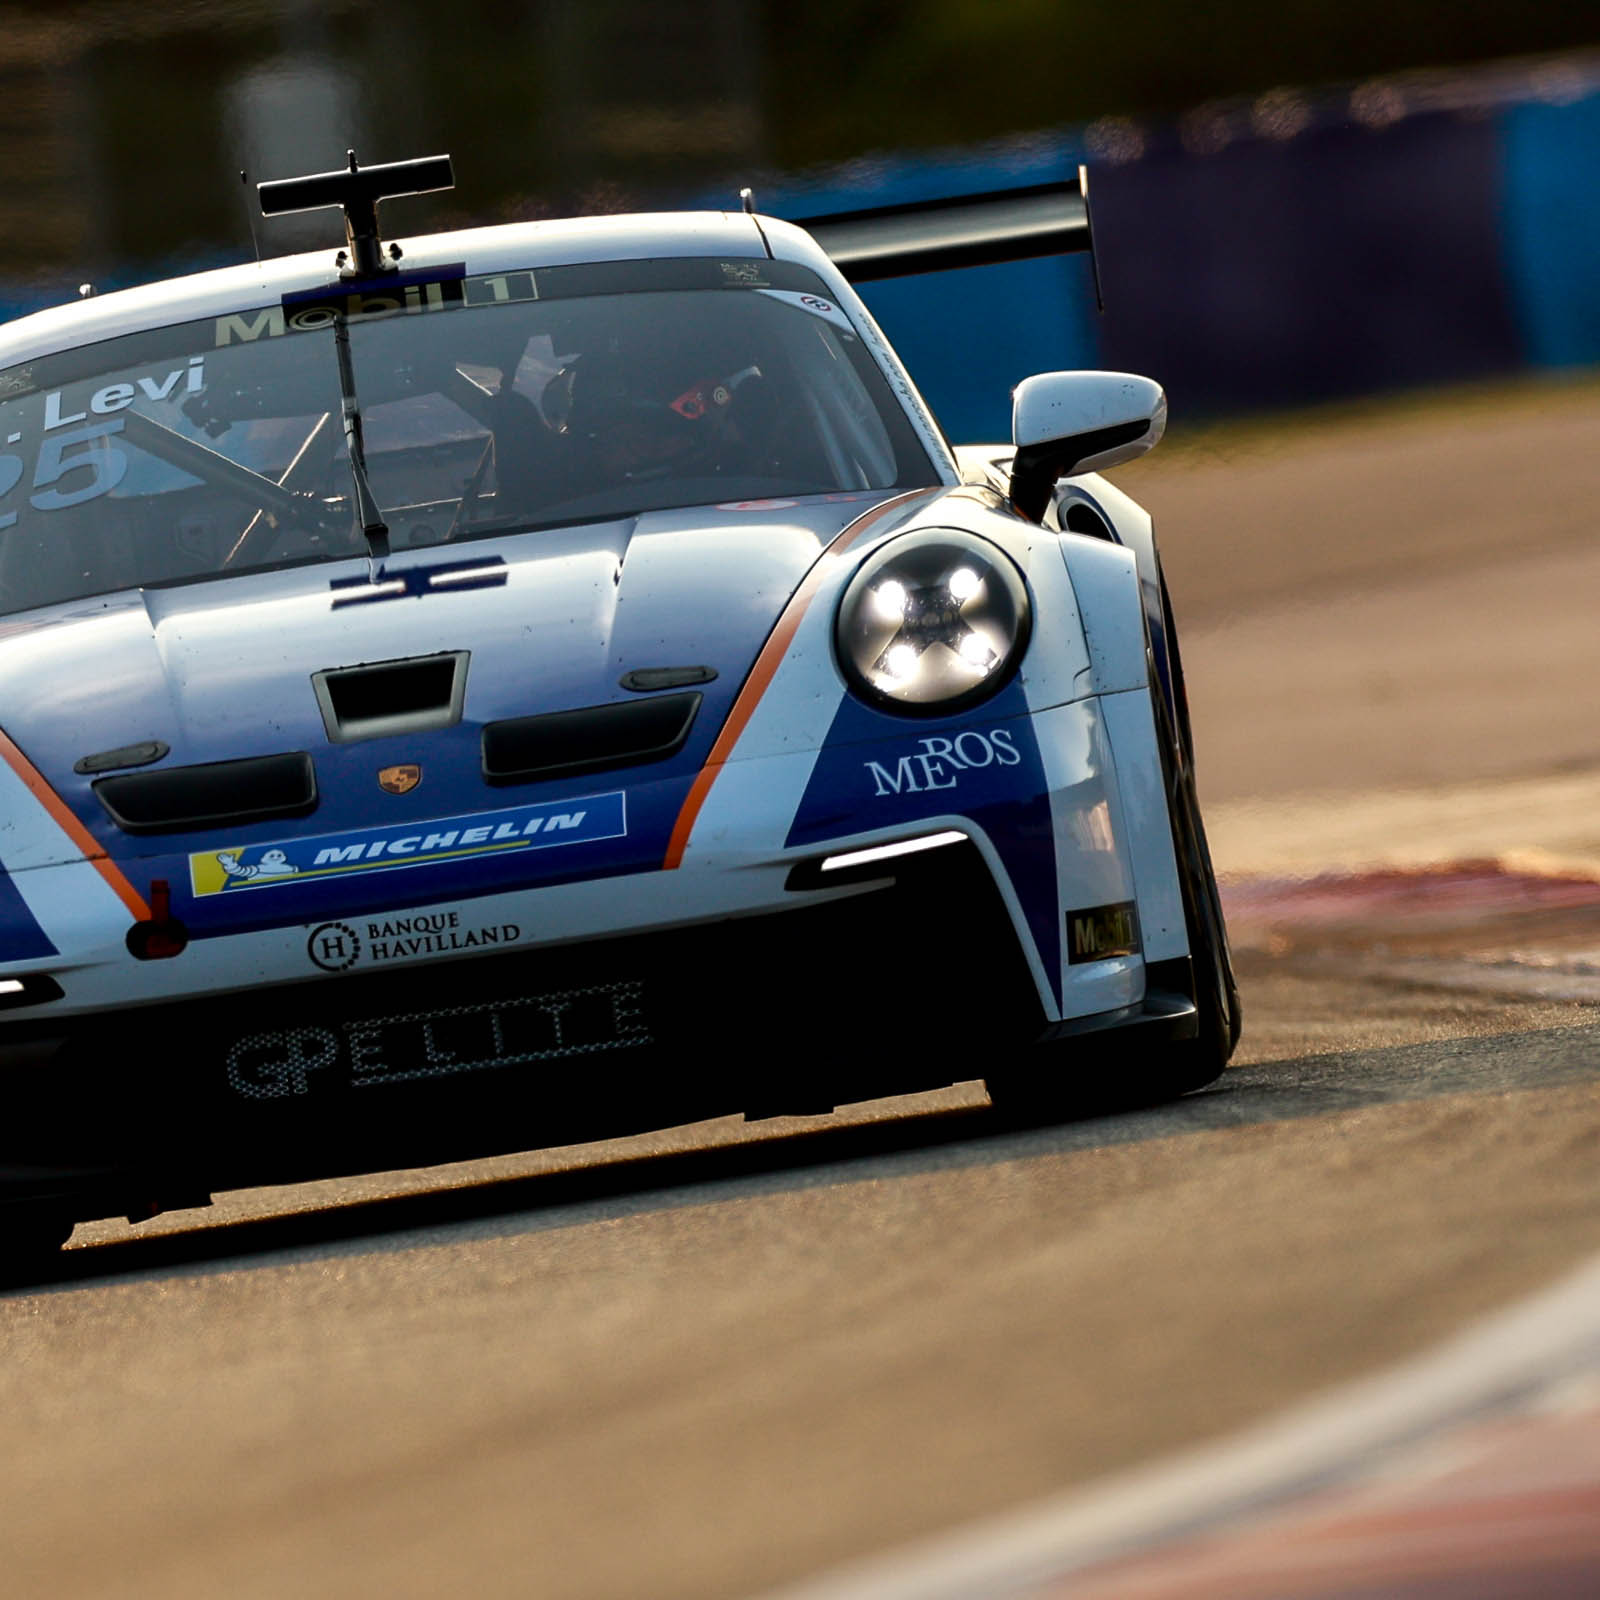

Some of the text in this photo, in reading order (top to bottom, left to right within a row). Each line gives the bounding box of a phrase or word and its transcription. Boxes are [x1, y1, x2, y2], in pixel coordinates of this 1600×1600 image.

[215, 277, 510, 347] Mobil 1
[43, 356, 205, 432] Levi
[863, 728, 1022, 797] MEROS
[313, 811, 587, 865] MICHELIN
[320, 936, 346, 960] H
[367, 911, 460, 939] BANQUE
[371, 924, 521, 960] HAVILLAND
[225, 990, 649, 1098] GP ELITE
